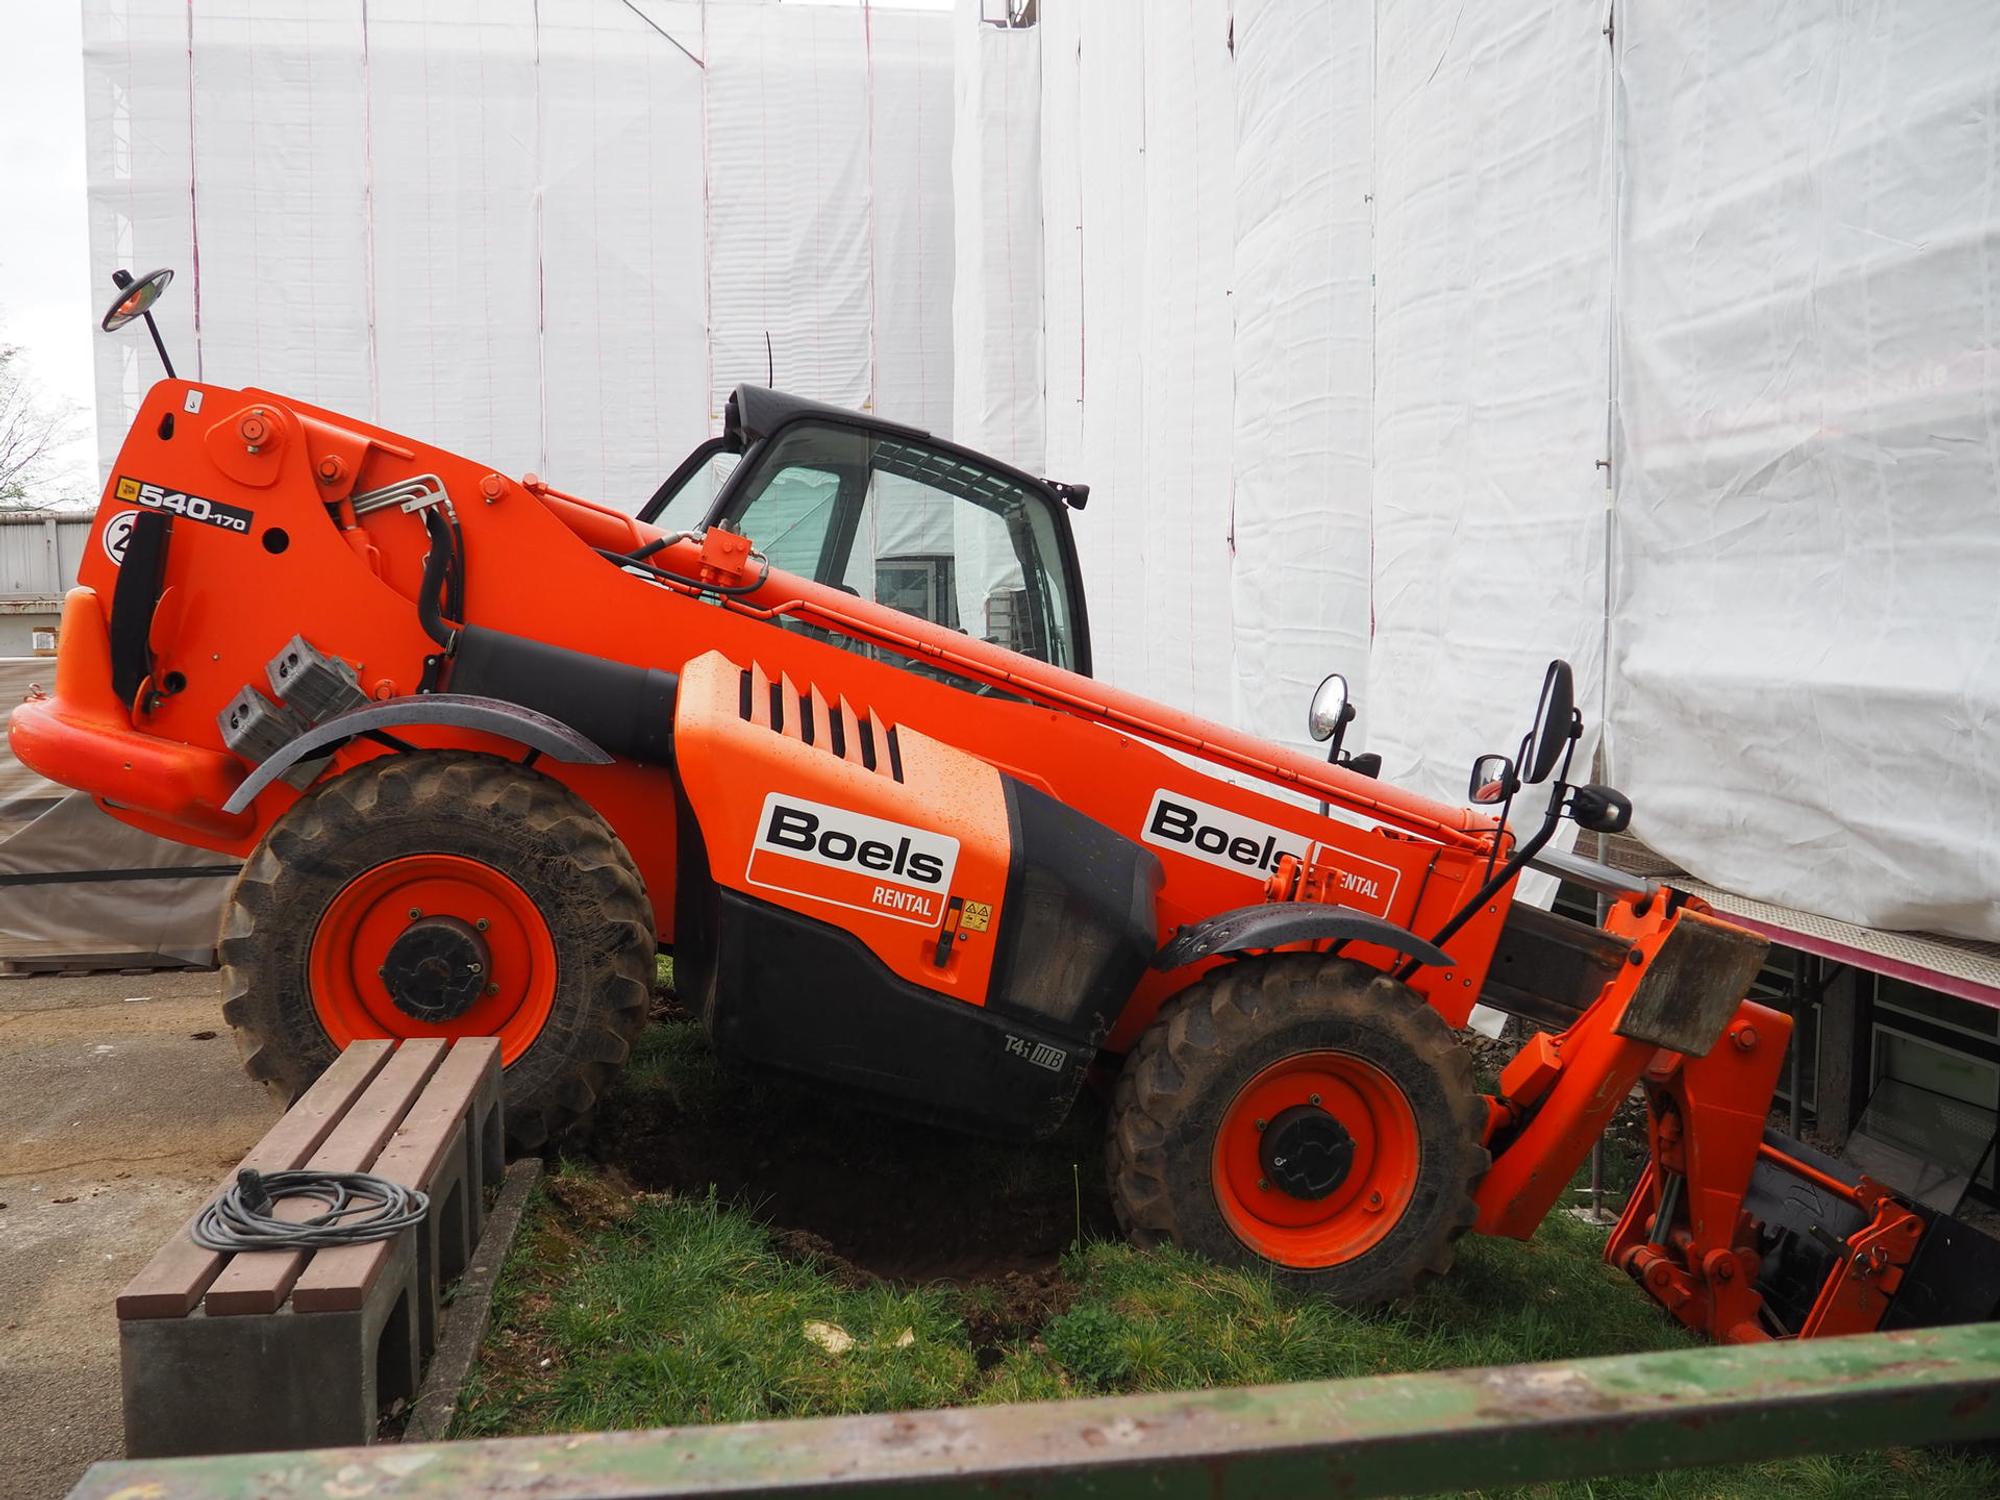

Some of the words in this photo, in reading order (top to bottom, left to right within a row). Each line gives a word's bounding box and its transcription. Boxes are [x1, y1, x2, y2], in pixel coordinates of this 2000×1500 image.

[138, 484, 247, 531] 540-170
[113, 523, 133, 551] 2
[766, 805, 944, 884] Boels
[1339, 871, 1380, 899] ENTAL
[872, 886, 932, 916] RENTAL
